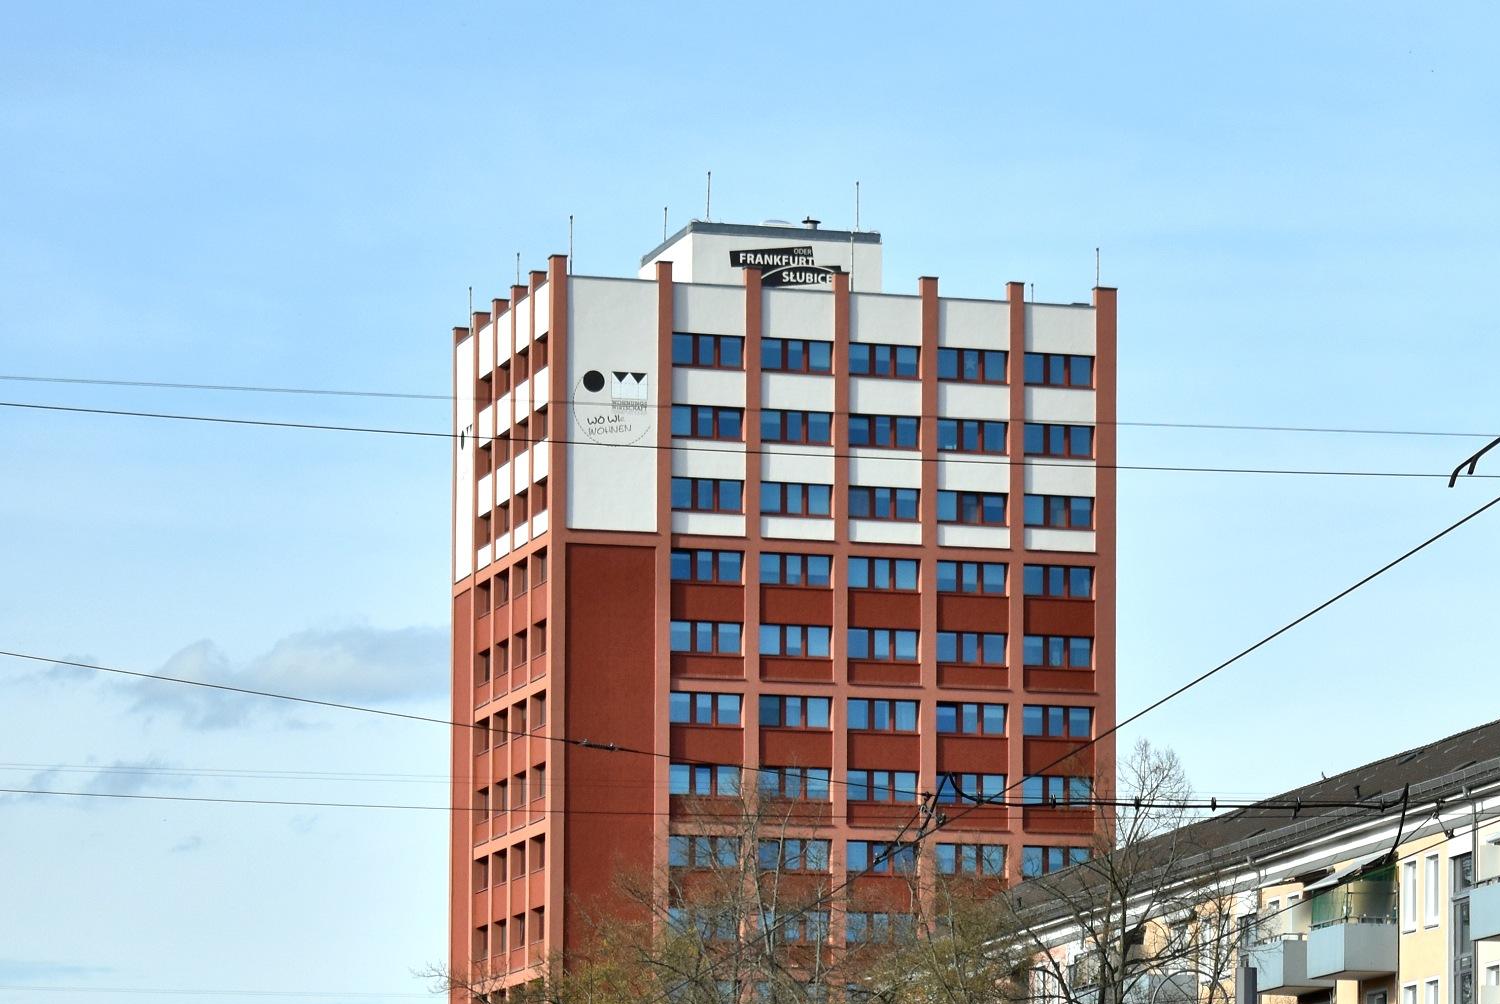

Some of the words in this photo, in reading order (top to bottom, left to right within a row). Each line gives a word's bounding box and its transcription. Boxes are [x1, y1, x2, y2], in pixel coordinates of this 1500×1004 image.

[793, 248, 813, 256] ODER
[739, 252, 816, 267] FRANKFURT
[781, 271, 833, 284] SŁUBICE
